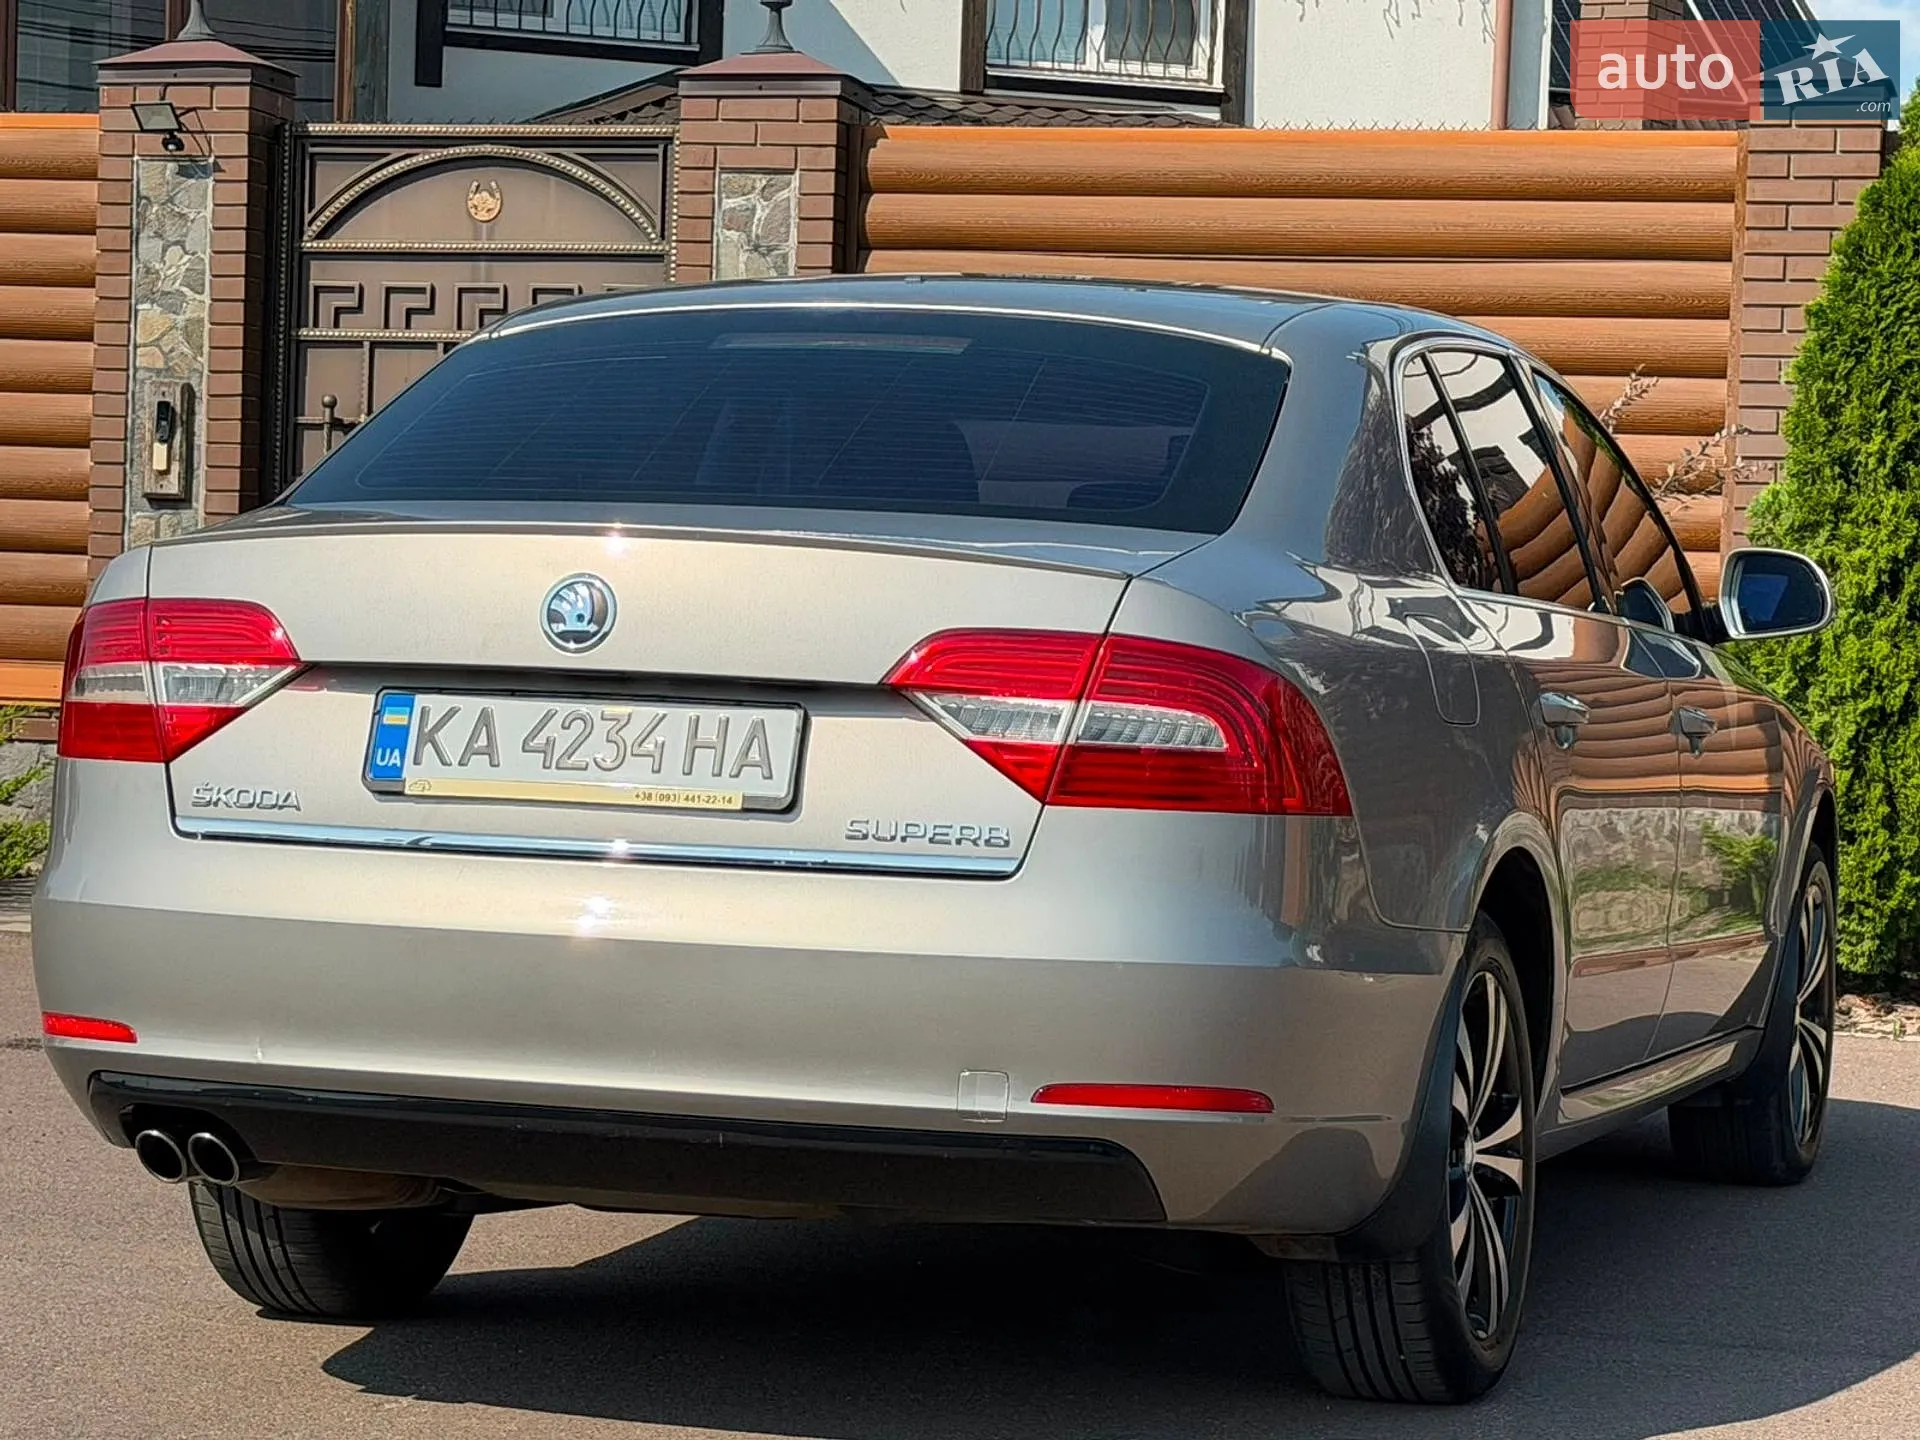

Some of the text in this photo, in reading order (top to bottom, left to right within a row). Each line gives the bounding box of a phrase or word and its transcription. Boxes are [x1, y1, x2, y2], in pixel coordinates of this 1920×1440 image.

[412, 705, 774, 780] KA 4234 HA
[375, 747, 402, 768] UA
[634, 790, 733, 805] +38 (093) 441-22-14
[844, 818, 1011, 849] SUPERB
